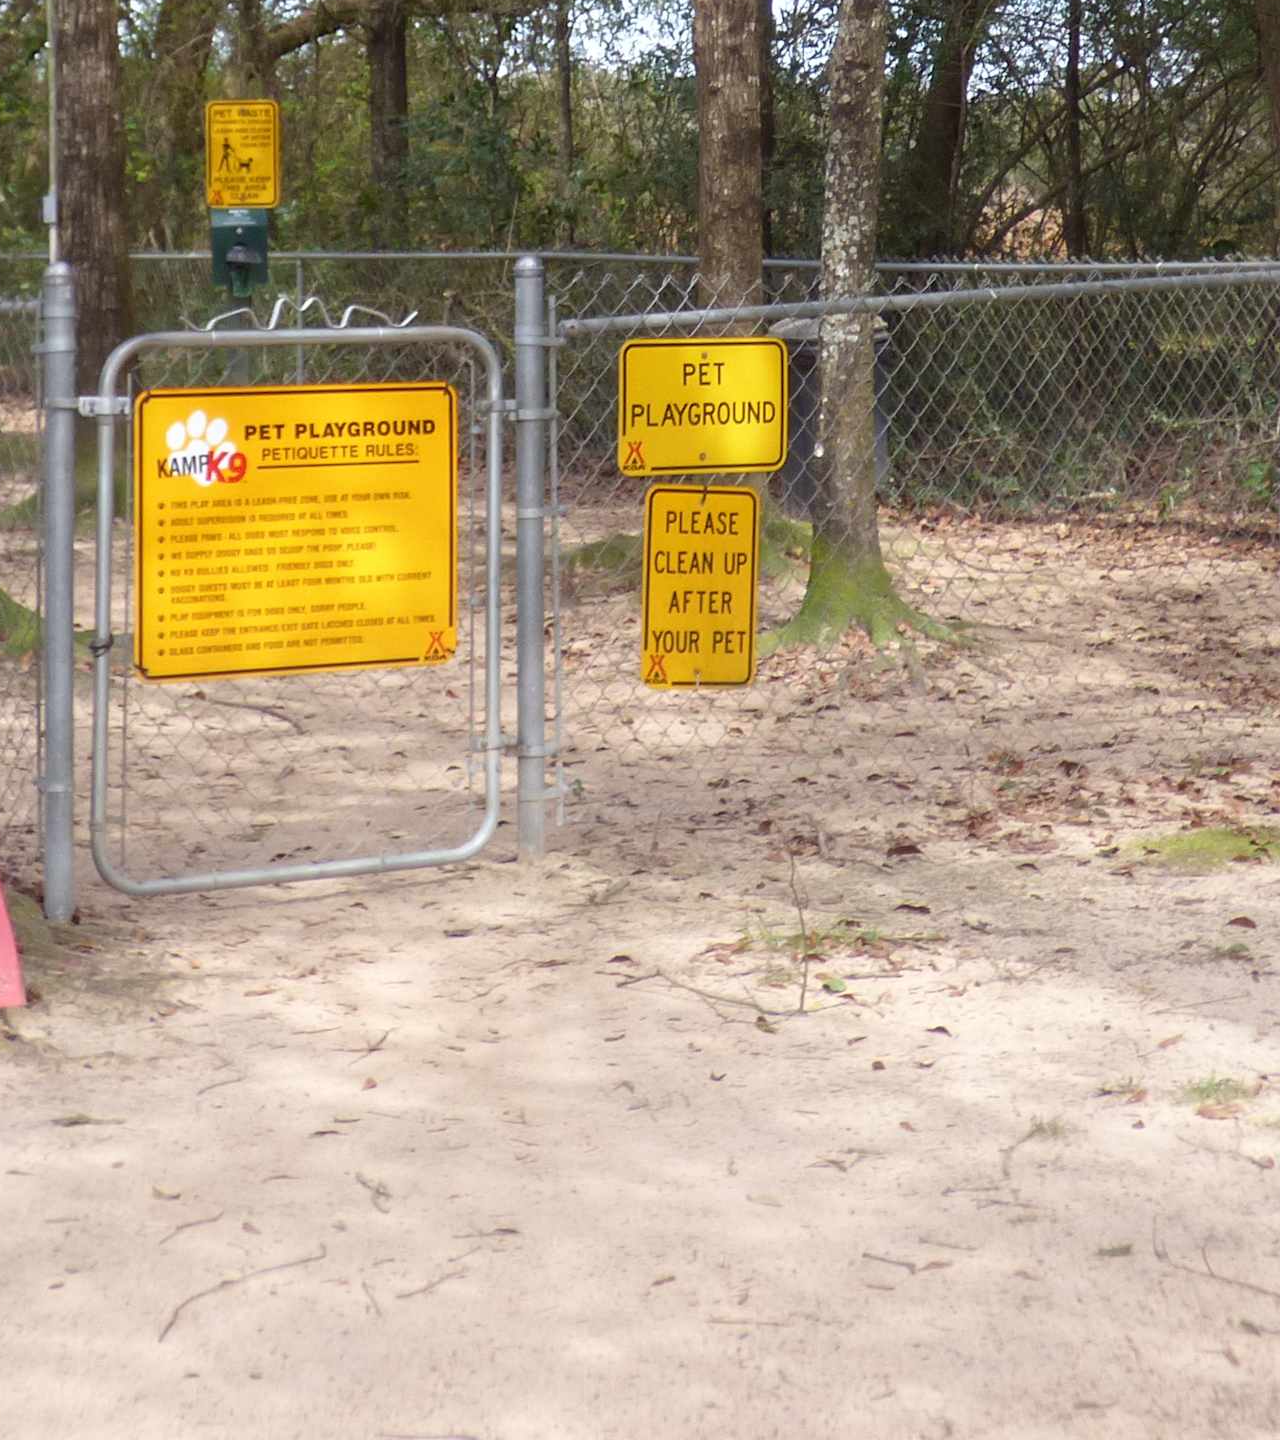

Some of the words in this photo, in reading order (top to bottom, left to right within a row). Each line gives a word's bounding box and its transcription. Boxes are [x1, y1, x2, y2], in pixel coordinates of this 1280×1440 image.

[213, 109, 232, 117] PET
[238, 108, 271, 117] WASTE
[682, 363, 724, 386] PET
[631, 401, 776, 427] PLAYGROUND
[244, 424, 285, 441] PET
[295, 420, 436, 440] PLAYGROUND
[262, 445, 359, 461] PETIQUETTE
[366, 442, 419, 458] RULES:
[157, 454, 208, 478] KAMP
[206, 451, 248, 483] K9
[665, 510, 739, 536] PLEASE
[654, 550, 714, 574] CLEAN
[724, 553, 748, 575] UP
[668, 591, 732, 614] AFTER
[652, 630, 700, 654] YOUR
[712, 630, 746, 654] PET
